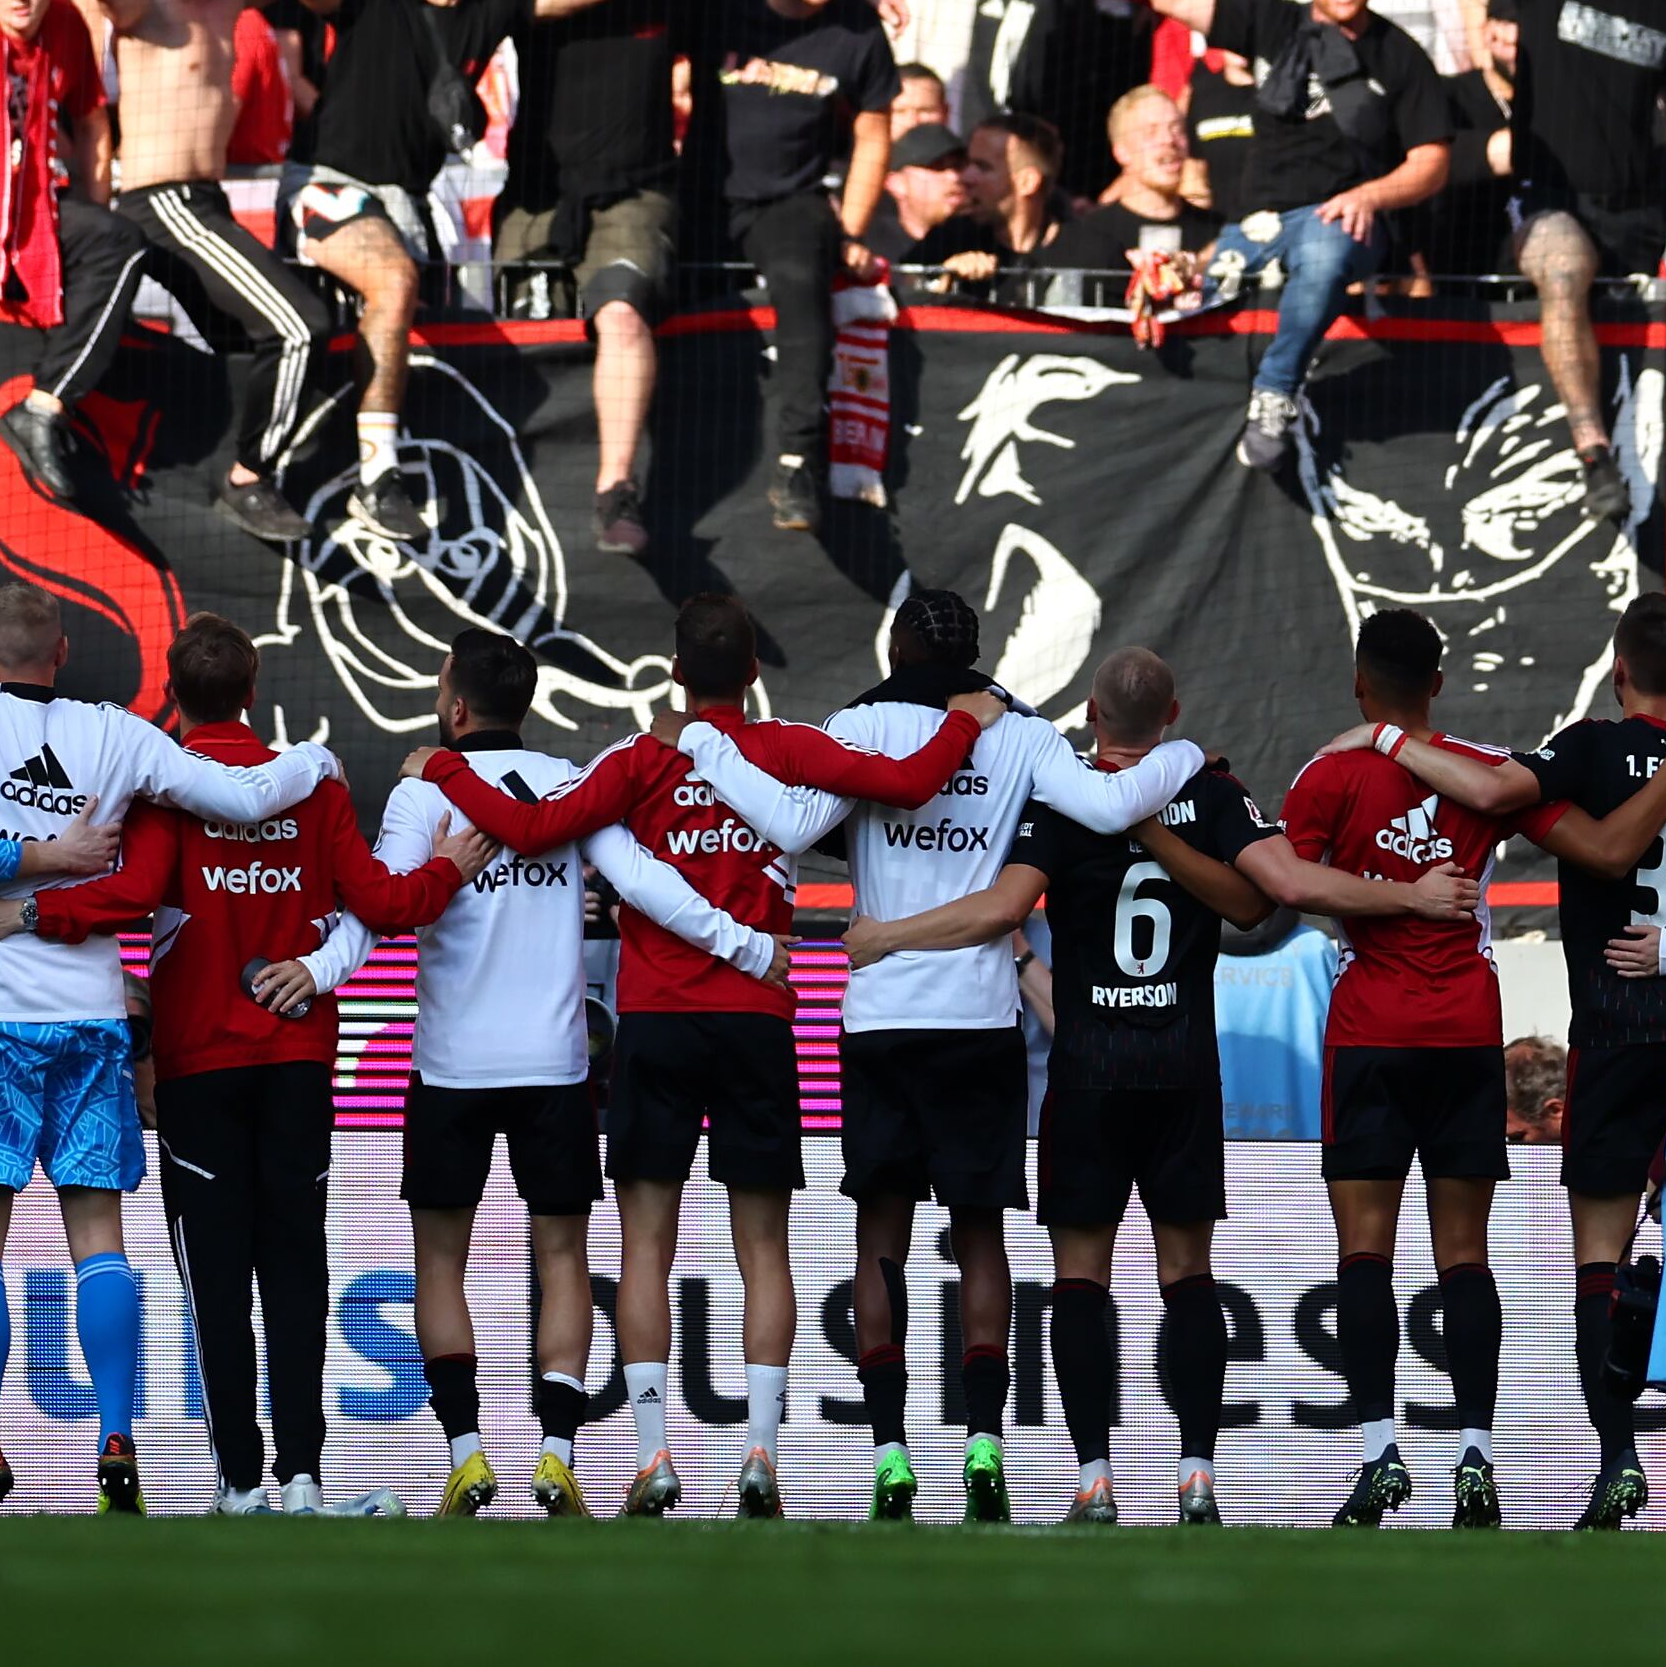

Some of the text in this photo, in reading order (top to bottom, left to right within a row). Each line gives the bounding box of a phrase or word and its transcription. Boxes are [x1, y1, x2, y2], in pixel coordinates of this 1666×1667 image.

[0, 777, 89, 816] adidas
[883, 819, 989, 853] wefox
[1376, 827, 1453, 864] adidas
[201, 861, 302, 895] wefox
[472, 854, 568, 894] wefox
[1113, 861, 1173, 977] 6
[1092, 982, 1177, 1008] RYERSON
